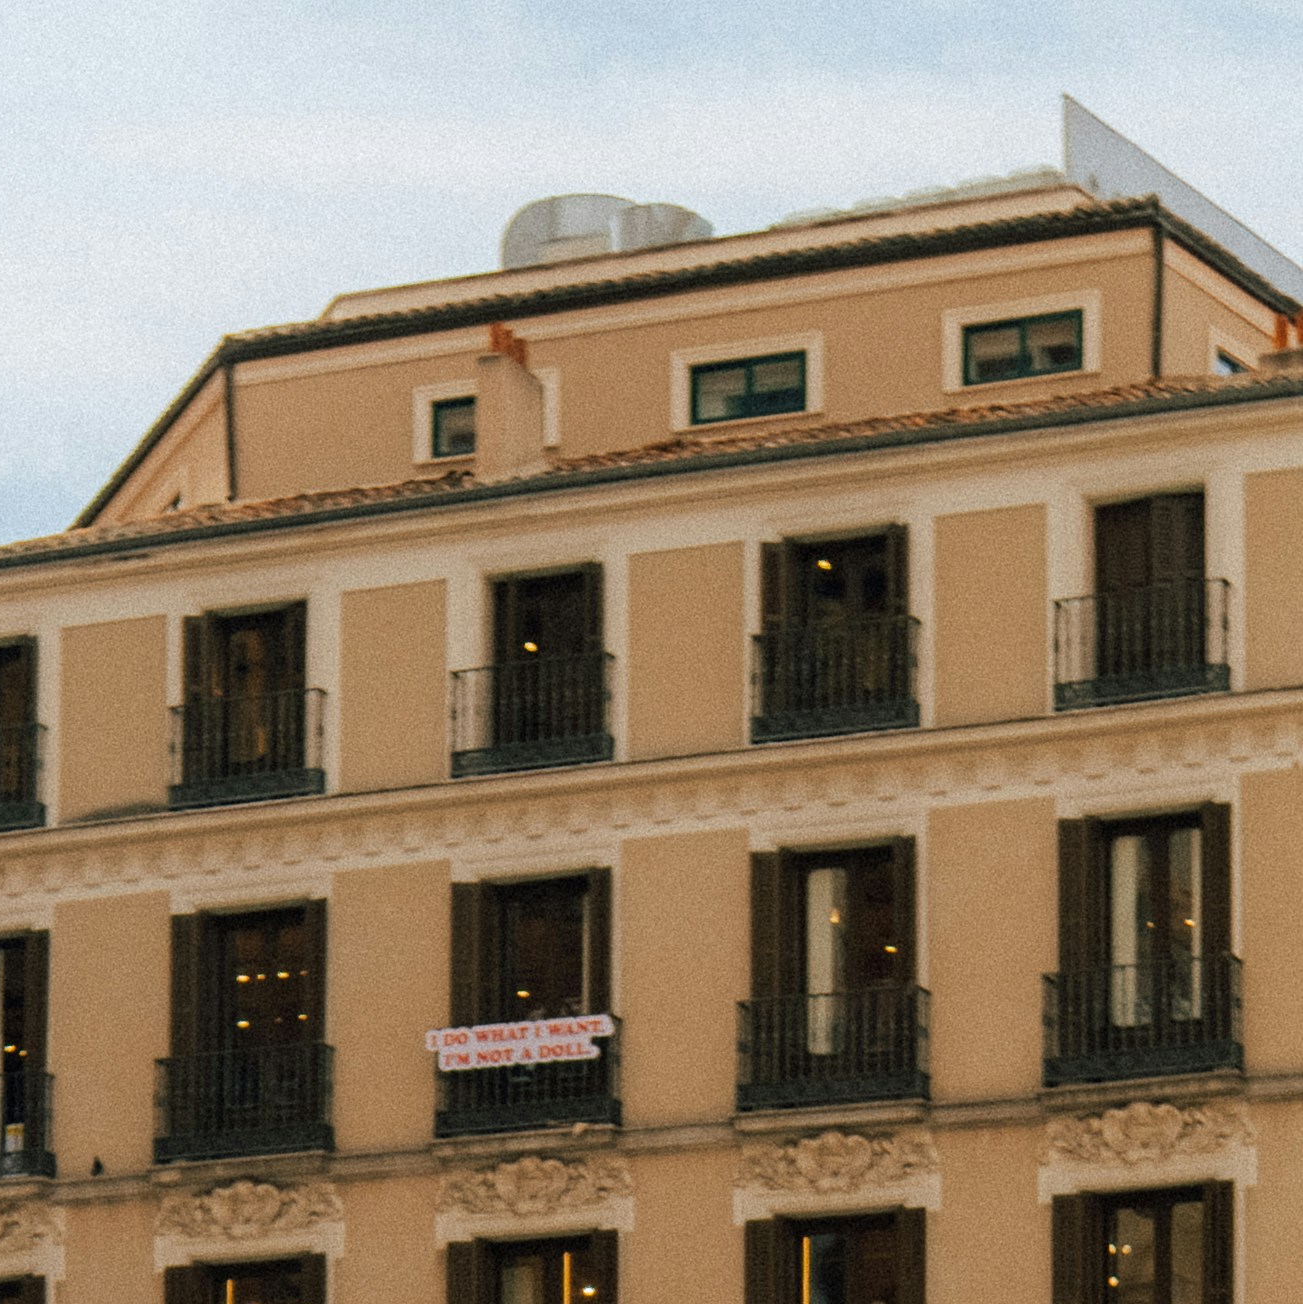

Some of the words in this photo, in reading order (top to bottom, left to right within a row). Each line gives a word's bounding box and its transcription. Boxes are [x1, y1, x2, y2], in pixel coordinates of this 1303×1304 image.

[443, 1033, 468, 1046] DO
[475, 1027, 529, 1042] WHAT
[444, 1053, 470, 1066] I'M
[476, 1049, 514, 1064] NOT
[521, 1048, 532, 1060] A
